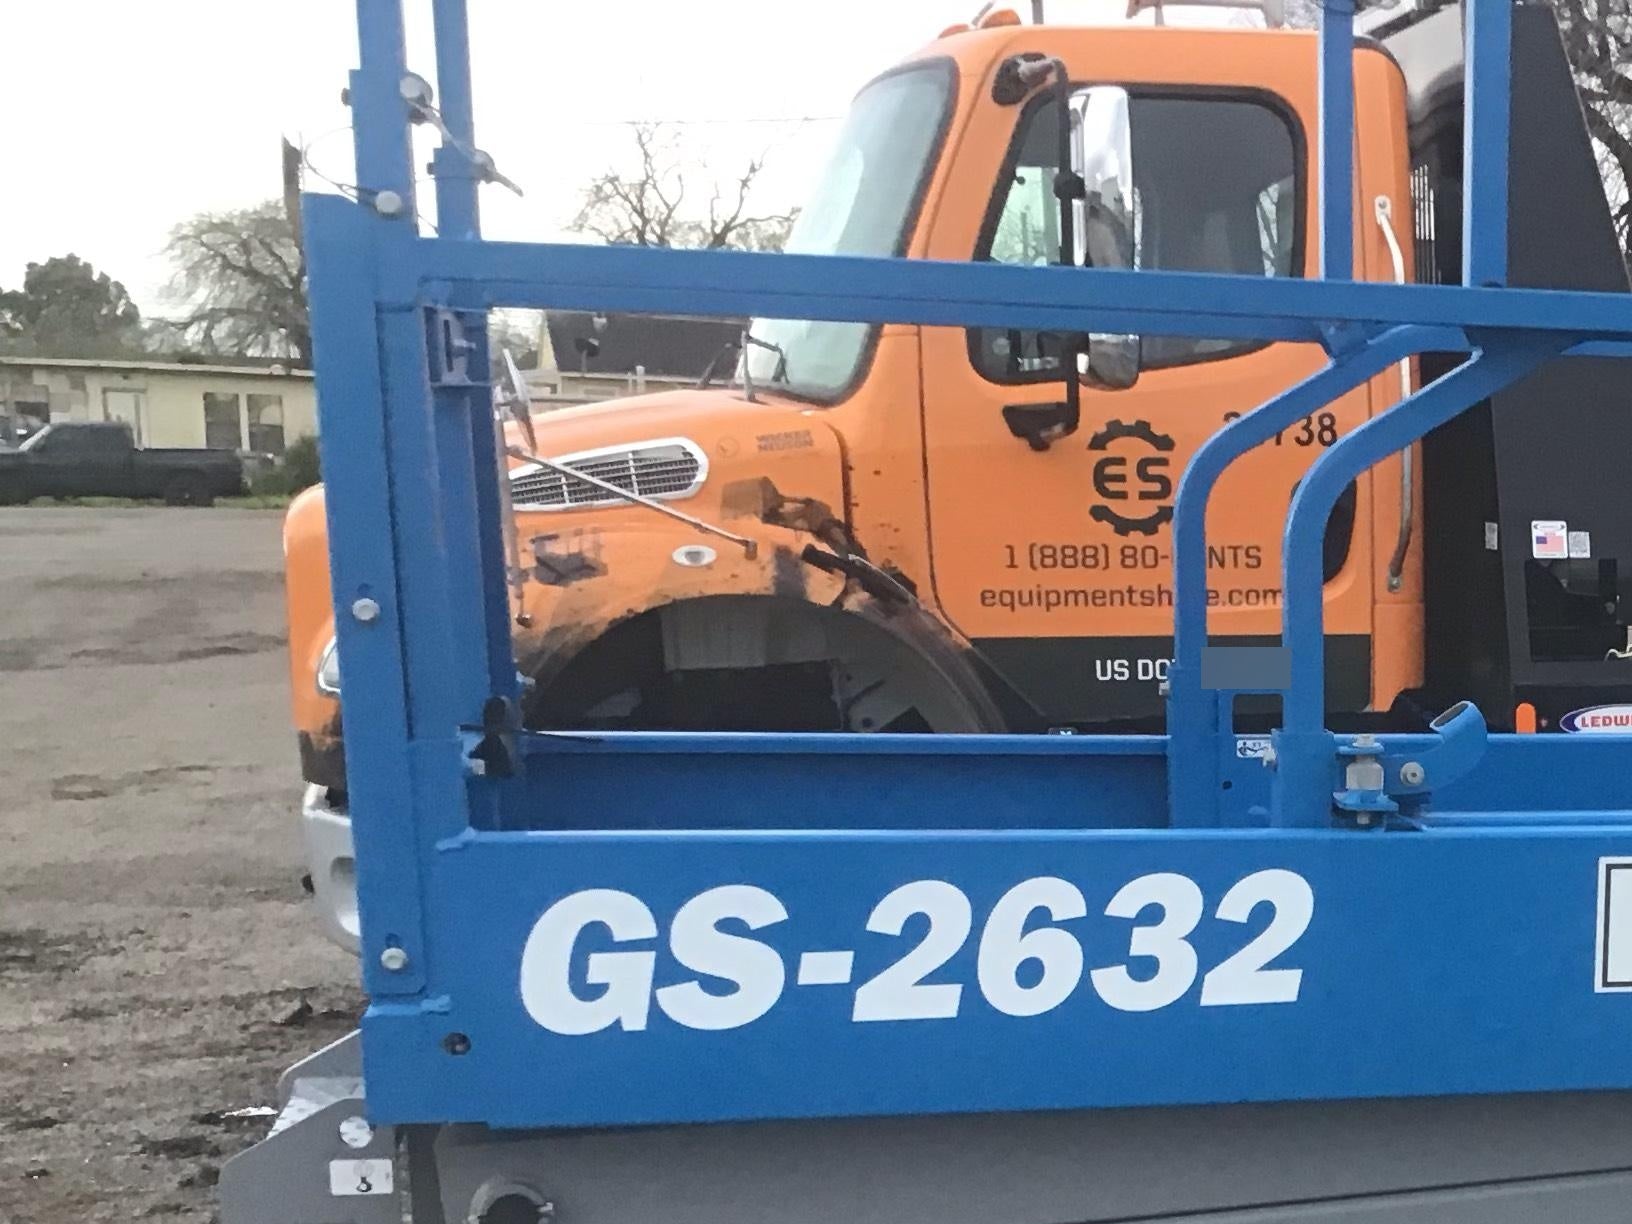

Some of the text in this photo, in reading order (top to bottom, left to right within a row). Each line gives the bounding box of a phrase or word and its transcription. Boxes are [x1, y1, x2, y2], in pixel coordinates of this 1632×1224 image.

[1093, 456, 1172, 500] ES
[1005, 543, 1262, 571] 1 (888) 80-NTS
[980, 584, 1283, 612] equipmentshe.com
[1095, 659, 1130, 681] US
[519, 868, 1315, 1036] GS-2632
